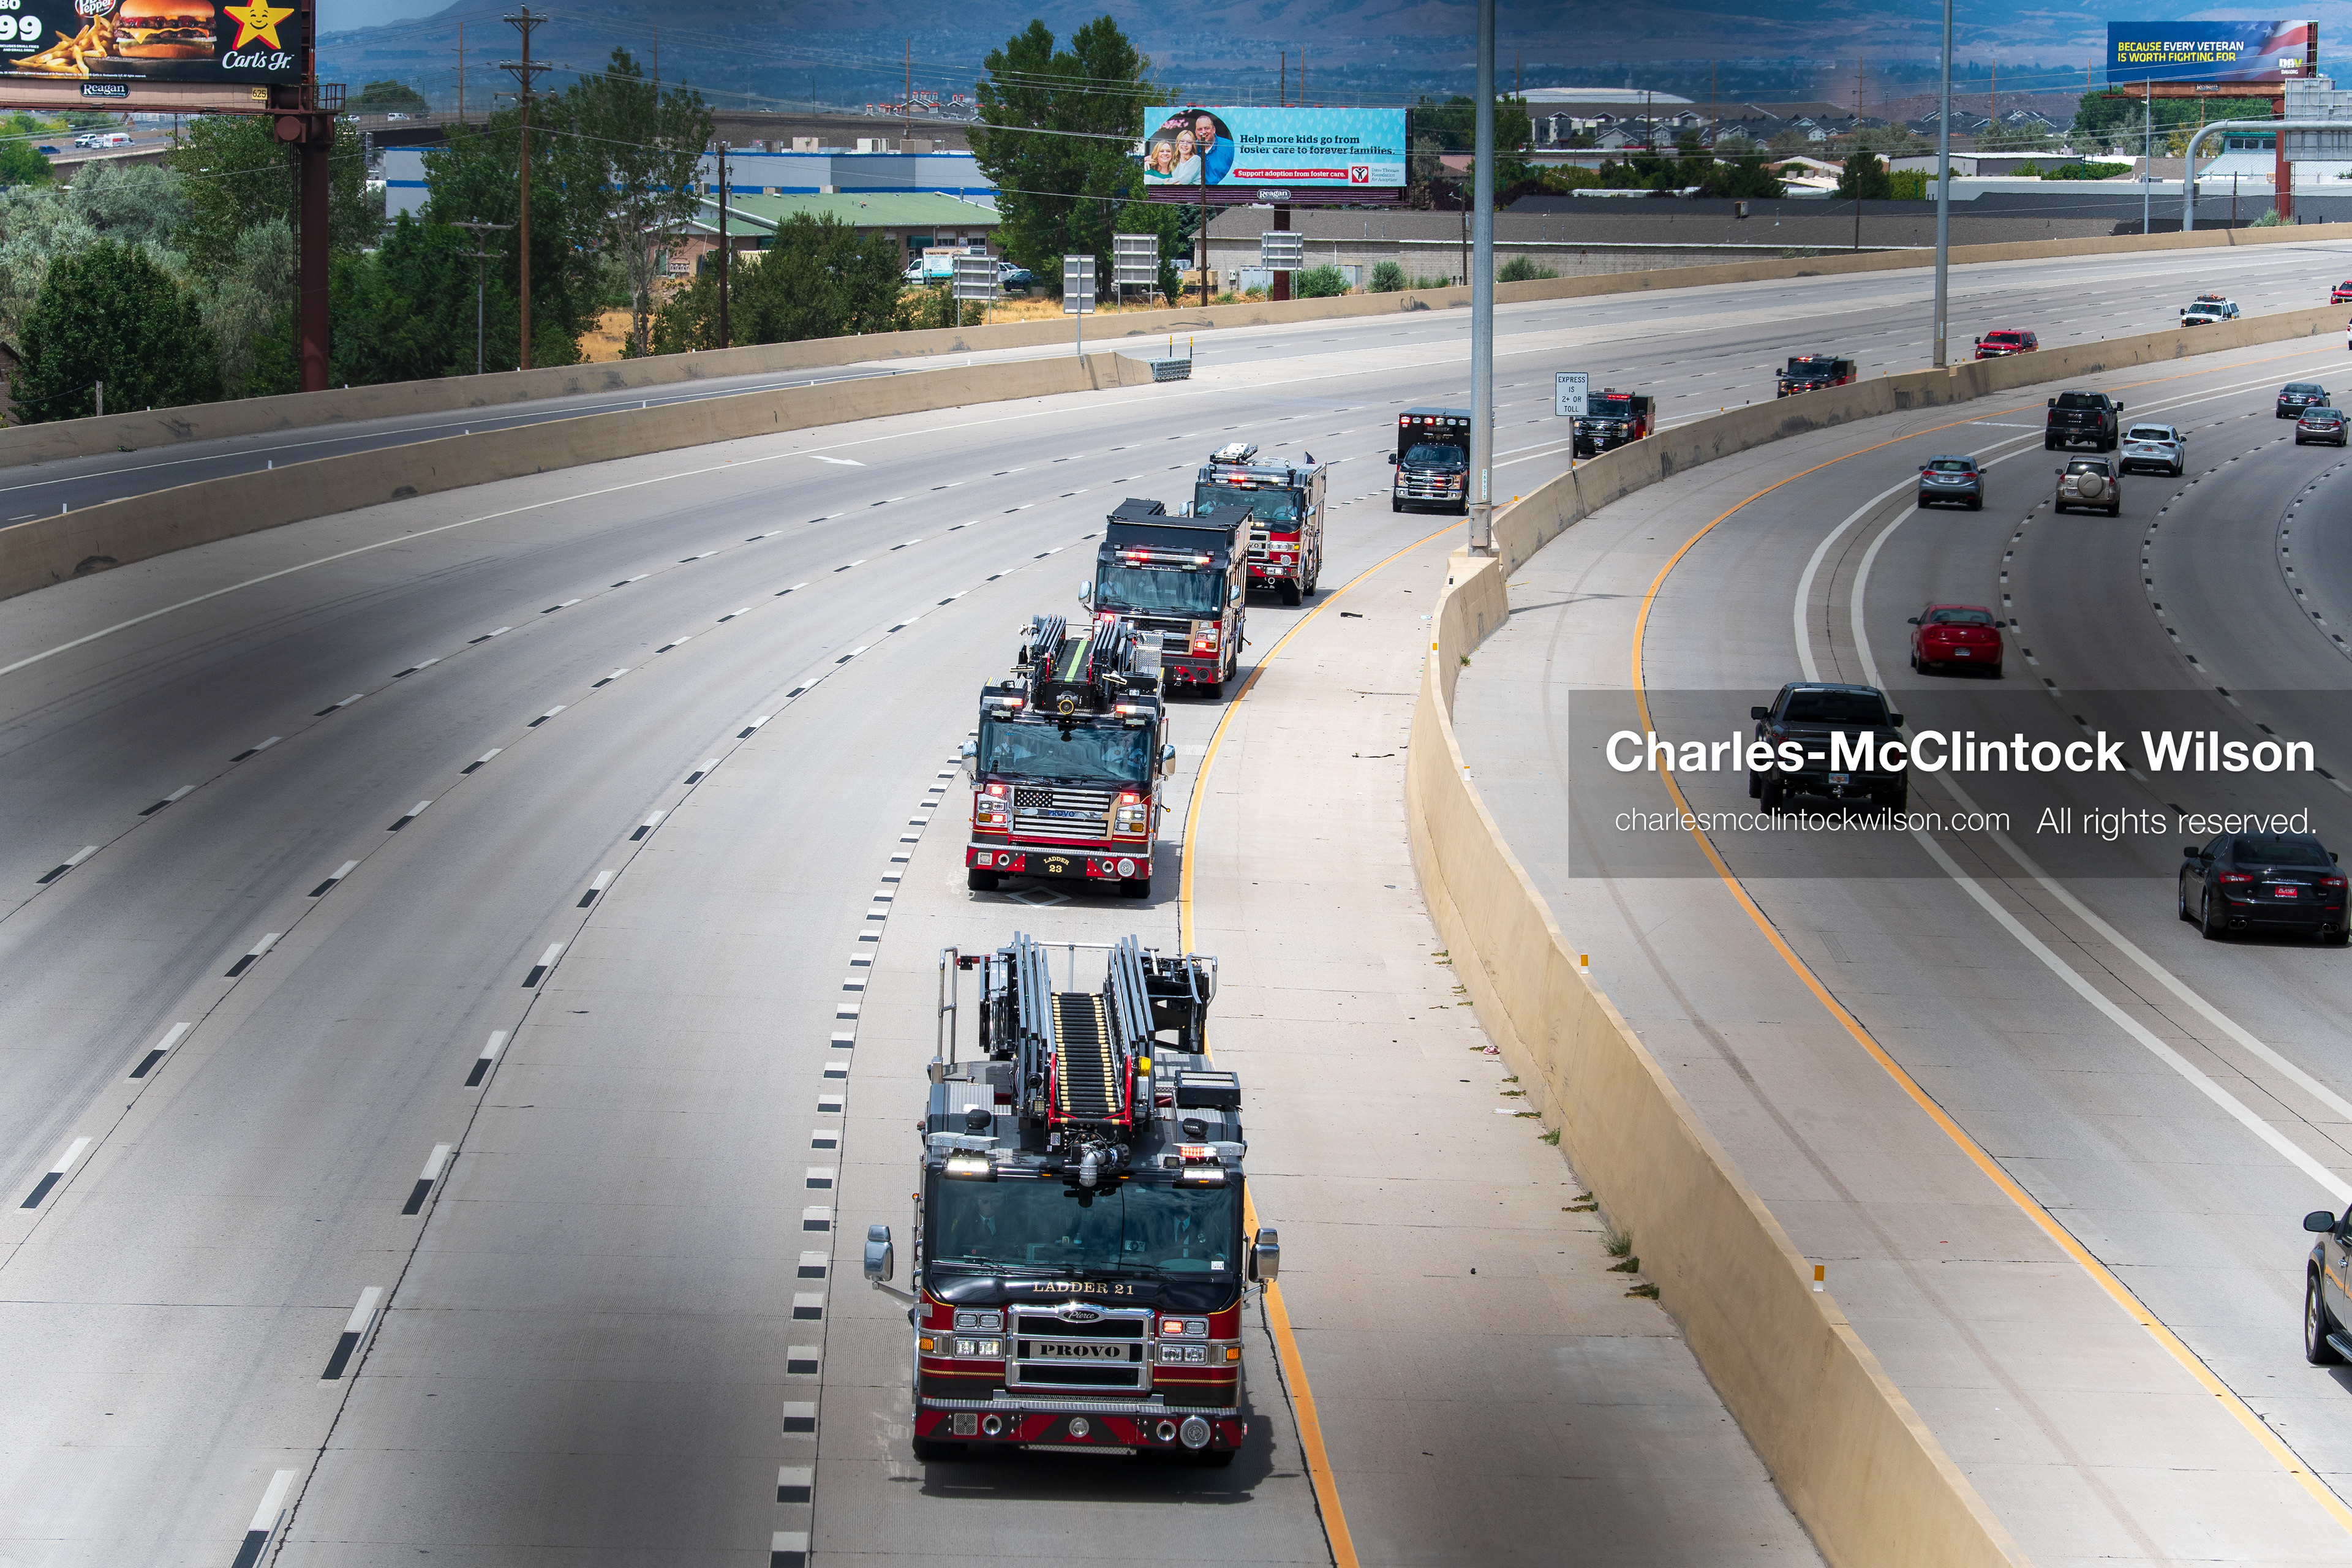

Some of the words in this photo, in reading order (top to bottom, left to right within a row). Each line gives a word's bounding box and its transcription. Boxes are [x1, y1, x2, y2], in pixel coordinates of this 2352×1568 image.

[2118, 42, 2162, 51] BECAUSE
[2163, 42, 2195, 51] EVERY
[2197, 41, 2244, 51] VETERAN
[222, 51, 267, 69] Carl's
[268, 52, 292, 70] Jr.
[2118, 53, 2127, 62] IS
[2129, 53, 2166, 62] WORTH
[2168, 52, 2214, 61] FIGHTING
[2216, 52, 2236, 61] FOR
[83, 85, 125, 95] Reagan
[1240, 135, 1264, 144] Help
[1320, 137, 1333, 145] go
[1335, 135, 1360, 144] from
[1240, 145, 1269, 154] foster
[1310, 146, 1347, 154] forever
[1349, 146, 1395, 155] families.
[1044, 856, 1069, 865] LADDER
[1033, 1282, 1108, 1294] LADDER
[1115, 1284, 1133, 1295] 21
[1040, 1344, 1120, 1357] PROVO
